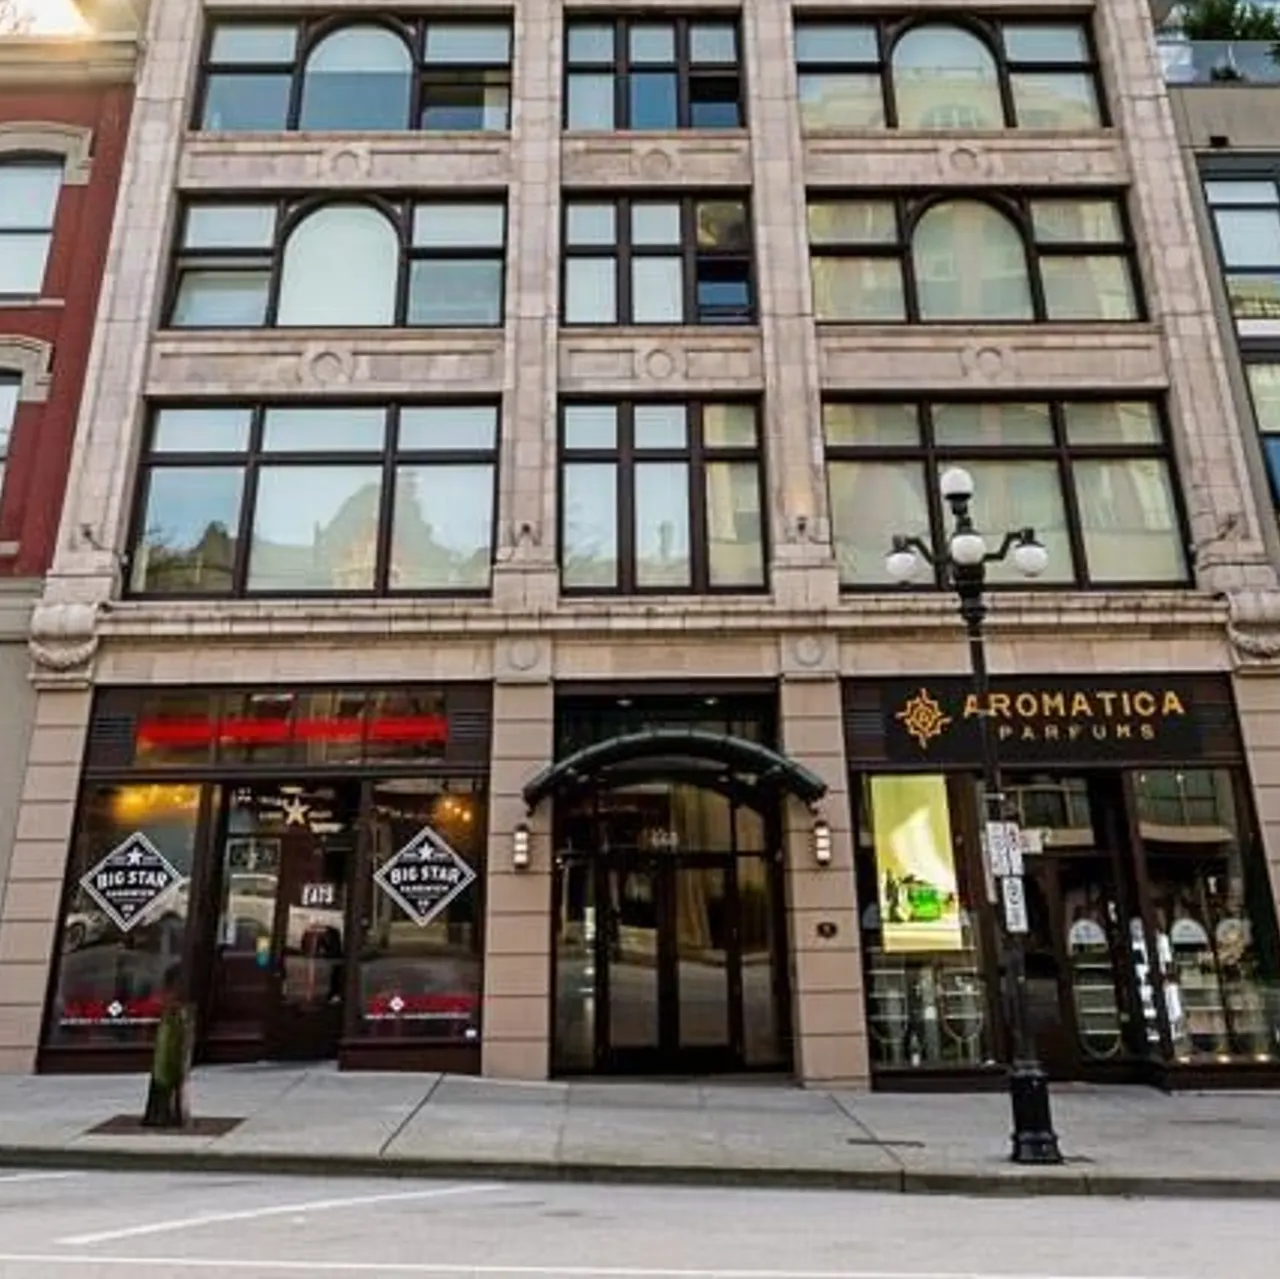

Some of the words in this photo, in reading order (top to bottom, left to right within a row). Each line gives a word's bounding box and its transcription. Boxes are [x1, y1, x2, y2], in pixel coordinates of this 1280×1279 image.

[962, 690, 1186, 719] AROMATICA
[998, 723, 1157, 741] PARFUMS
[96, 871, 125, 890] BIG
[128, 870, 168, 888] STAR
[390, 867, 419, 885] BIG
[421, 865, 461, 883] STAR
